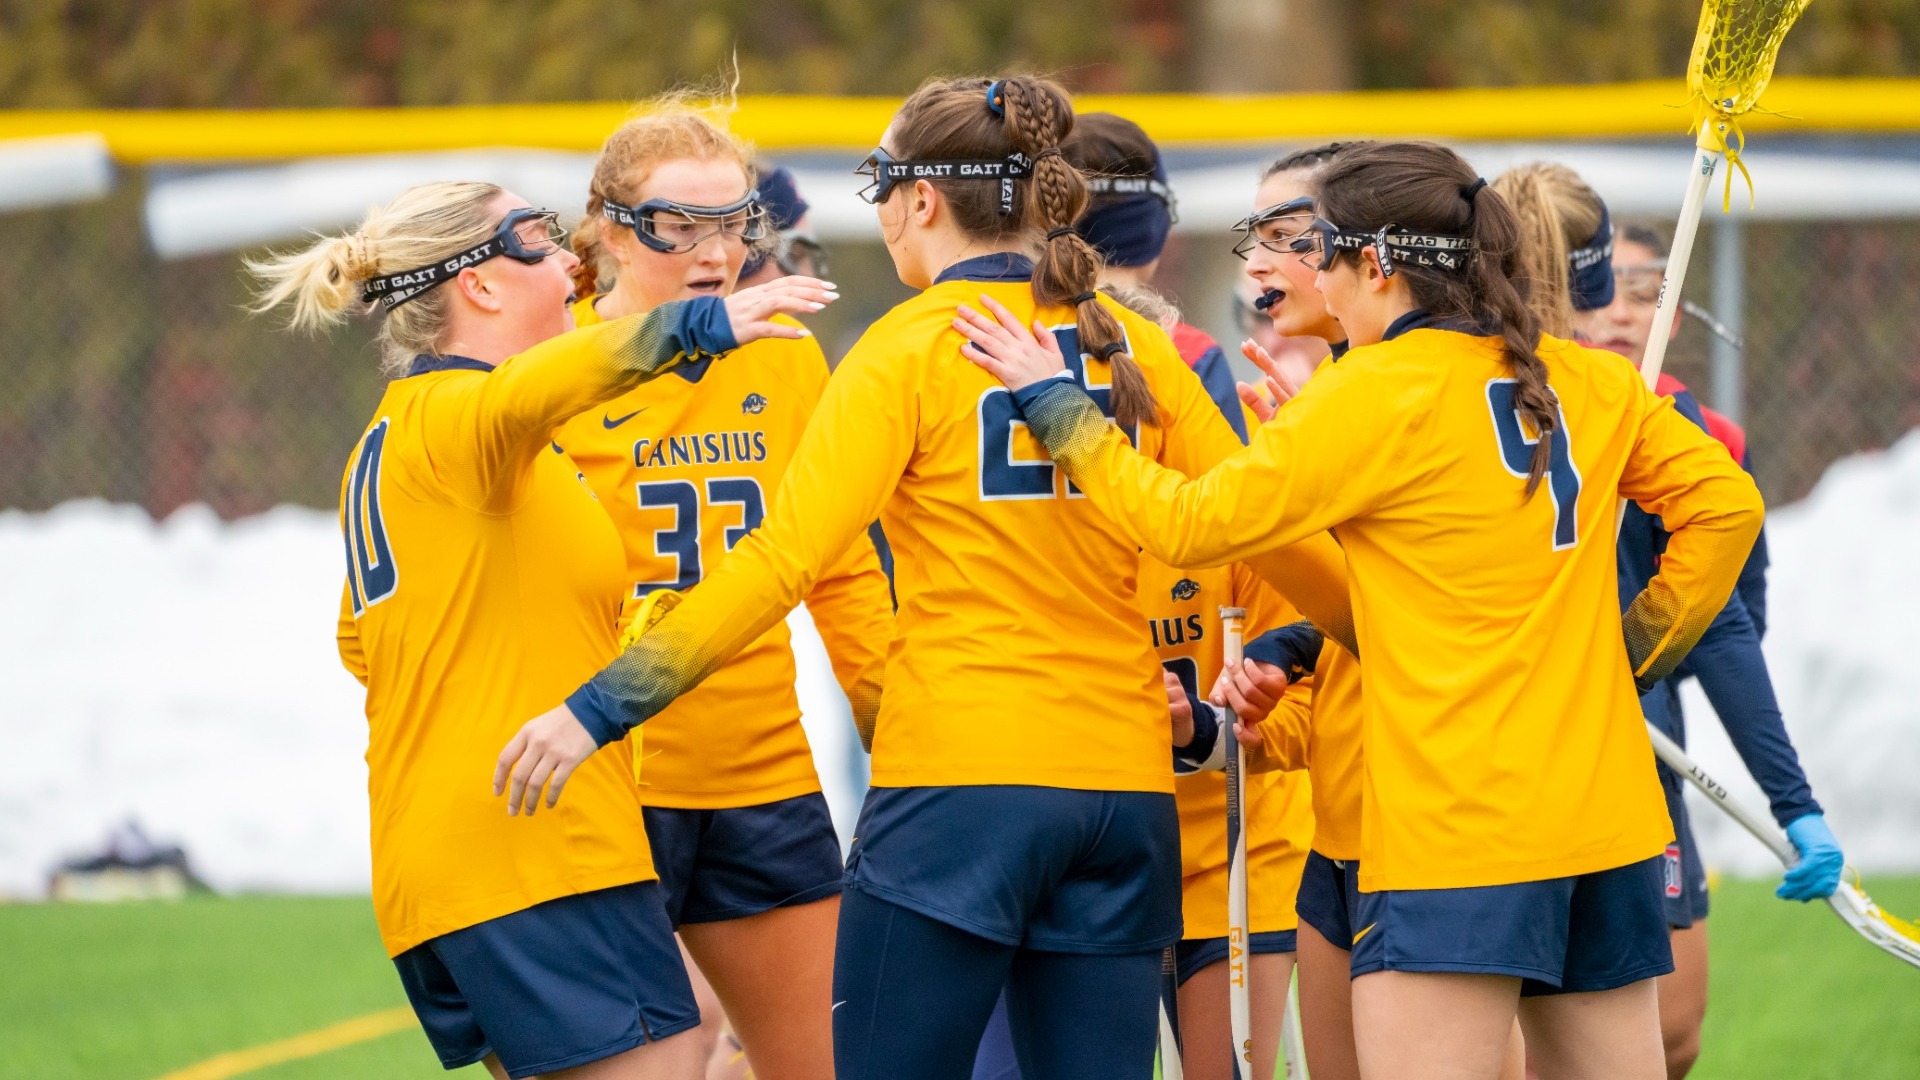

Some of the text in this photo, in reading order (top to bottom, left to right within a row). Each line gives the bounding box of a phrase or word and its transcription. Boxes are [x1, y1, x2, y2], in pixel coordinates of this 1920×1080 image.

[914, 164, 953, 176] GAIT
[960, 163, 1003, 175] GAIT
[1331, 234, 1363, 248] AIT
[390, 268, 436, 288] GAIT
[444, 243, 492, 273] GAIT
[632, 430, 767, 468] CANISIUS
[1485, 377, 1582, 552] 9
[344, 416, 399, 620] 10
[1229, 926, 1244, 988] GAIT
